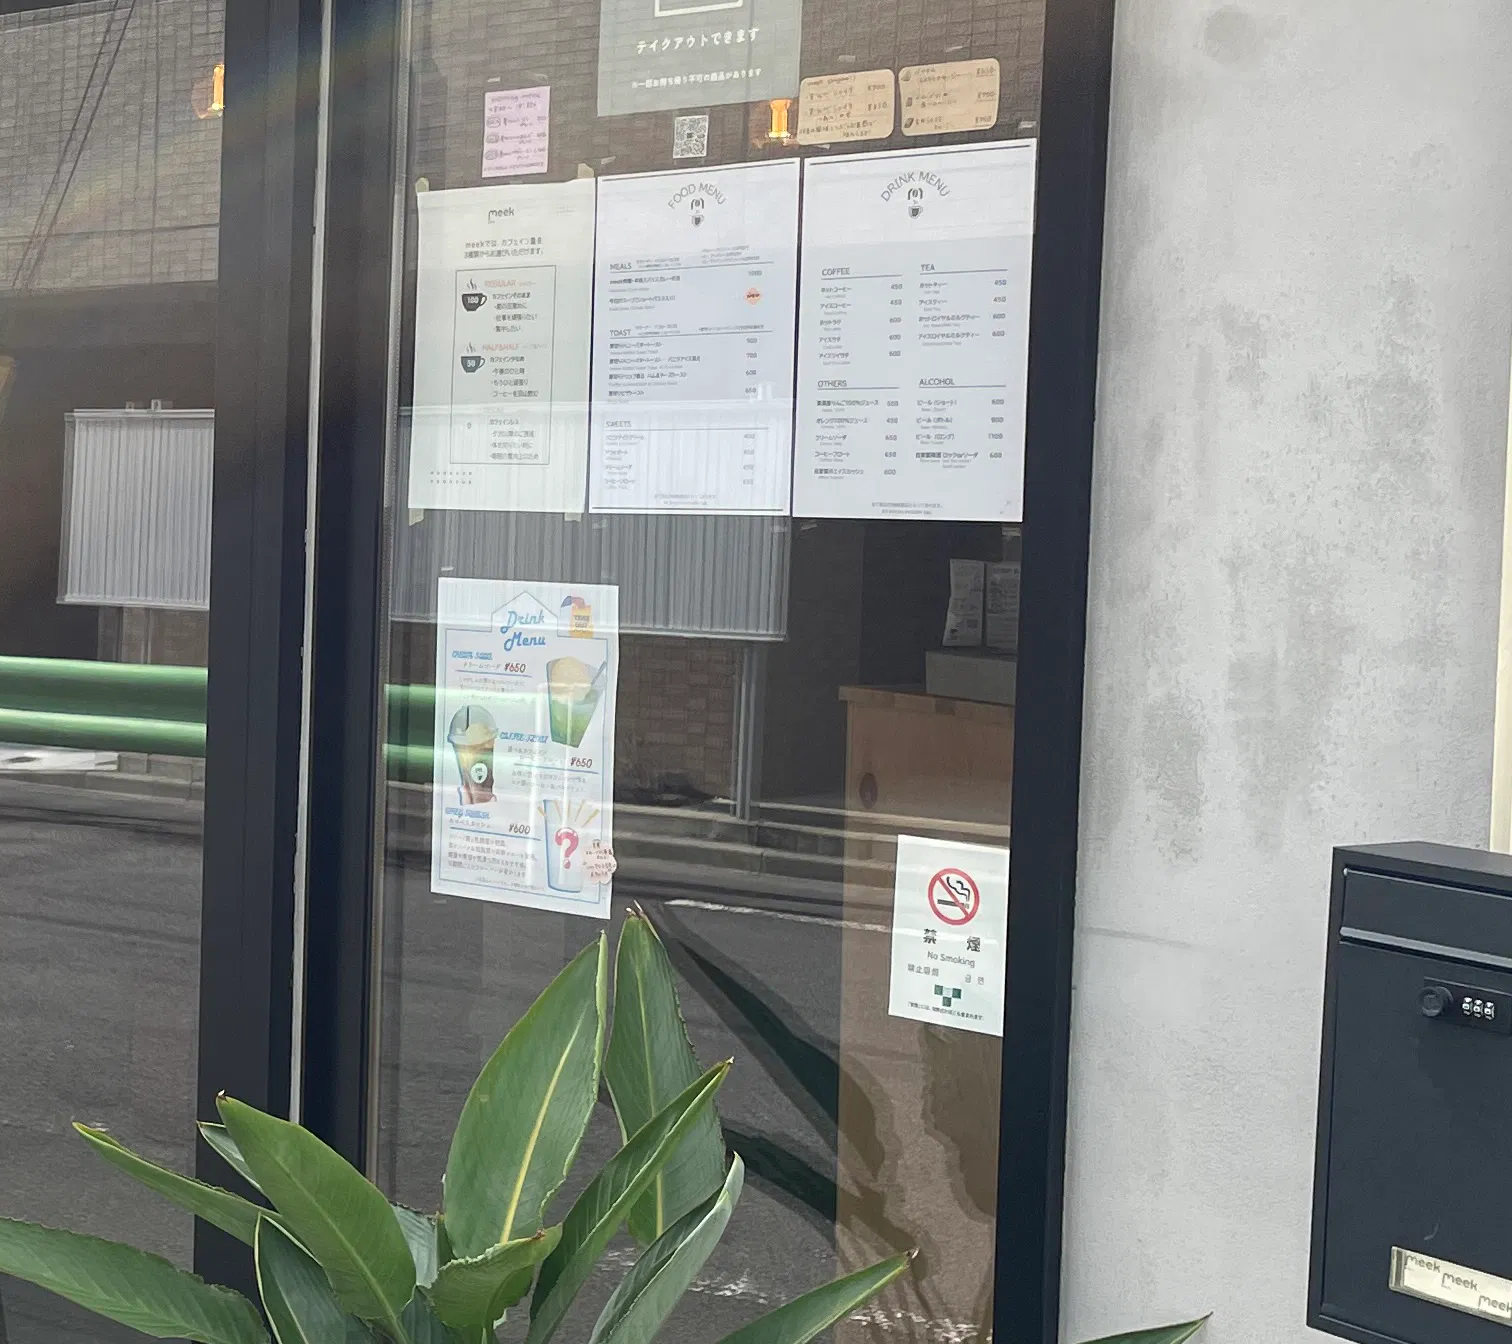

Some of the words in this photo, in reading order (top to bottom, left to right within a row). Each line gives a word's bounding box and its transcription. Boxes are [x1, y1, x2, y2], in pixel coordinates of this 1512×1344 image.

[636, 24, 760, 54] テイクアウトできます
[881, 172, 916, 202] DRINK
[918, 171, 950, 197] MENU
[668, 183, 697, 209] FOOD
[699, 182, 726, 205] MENU
[488, 207, 515, 223] meek
[821, 267, 850, 276] COFFEE
[818, 380, 847, 388] OTHERS
[500, 610, 544, 634] Drink
[504, 631, 546, 651] Menu
[504, 662, 527, 673] ¥650
[570, 757, 593, 768] ¥650
[508, 823, 530, 835] ¥600
[927, 951, 939, 960] No
[940, 953, 975, 968] Smoking
[1405, 1255, 1441, 1273] meek
[1441, 1272, 1478, 1291] meek
